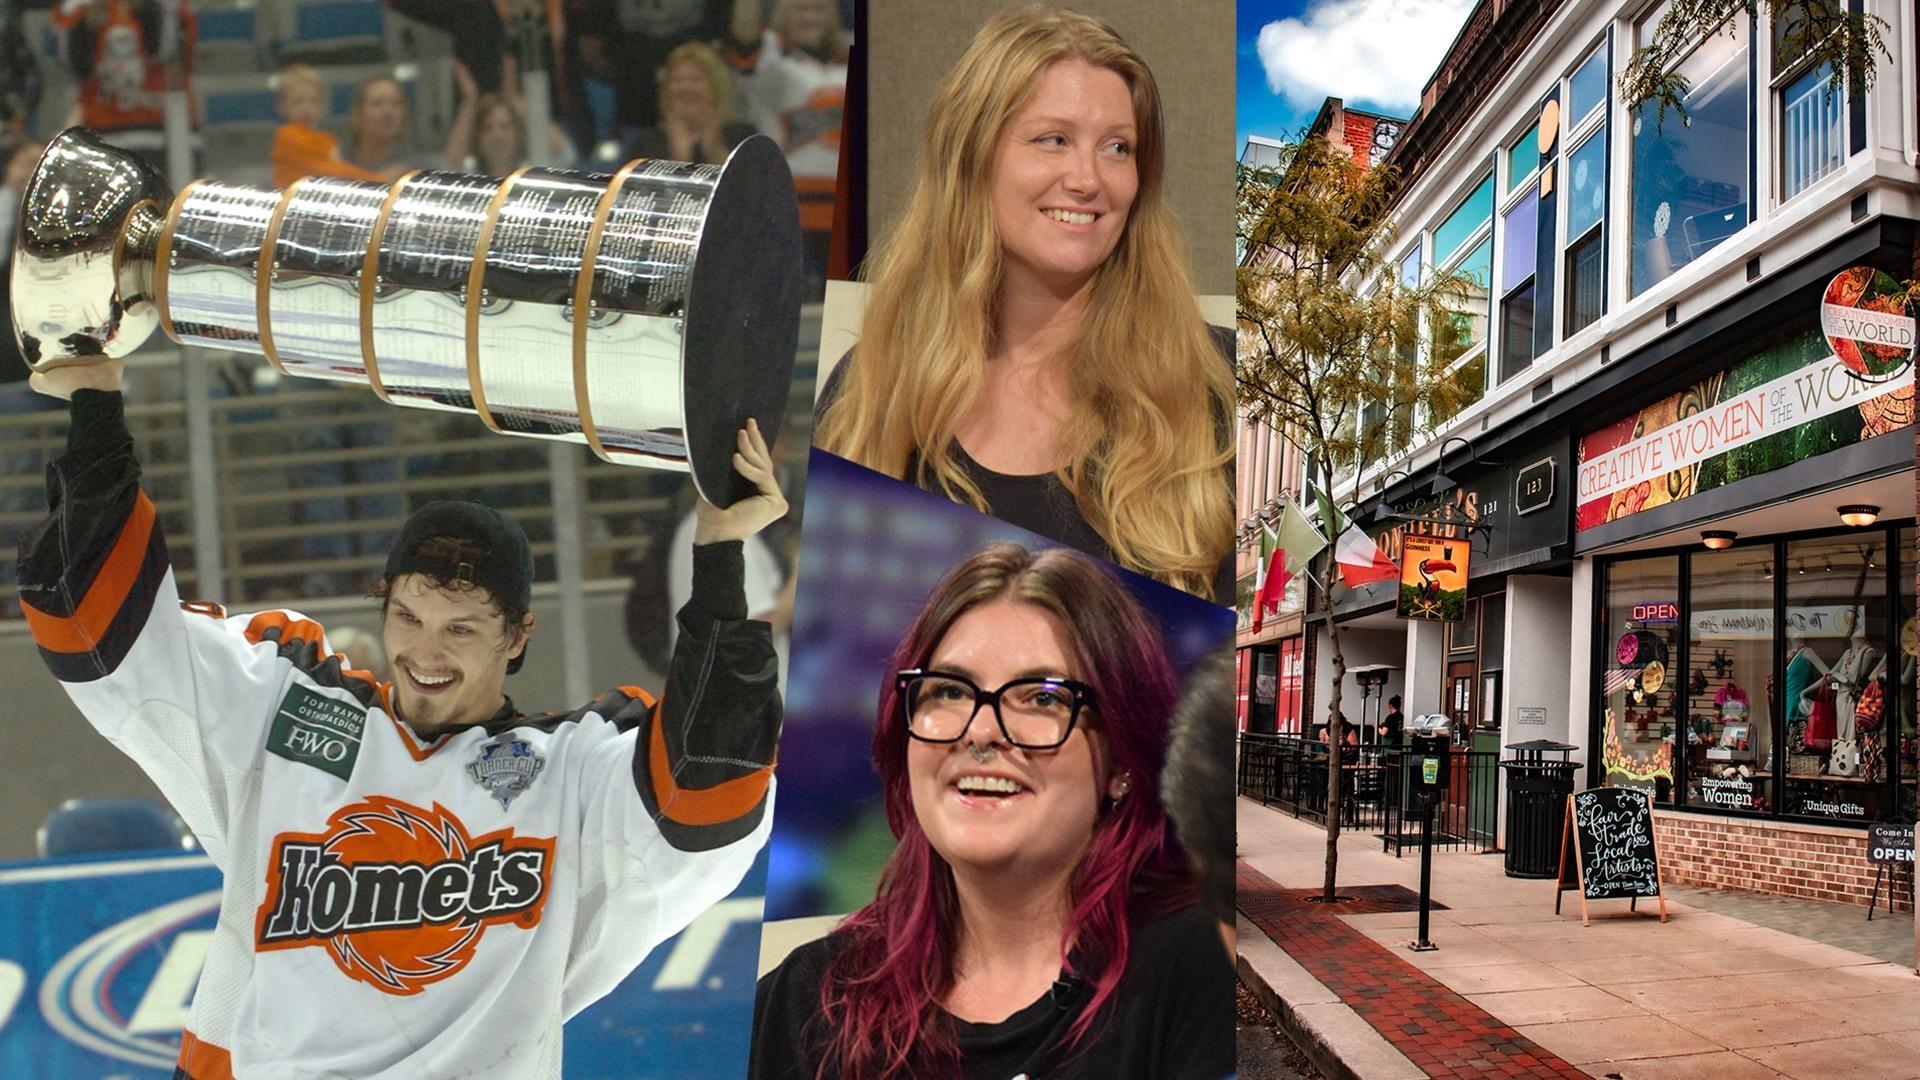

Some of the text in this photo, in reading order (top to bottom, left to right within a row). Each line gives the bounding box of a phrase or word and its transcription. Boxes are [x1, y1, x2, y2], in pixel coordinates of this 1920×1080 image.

[1827, 307, 1872, 322] CREATIVE
[1842, 318, 1911, 345] WORLD
[1771, 387, 1788, 407] OF
[1770, 406, 1794, 427] THE
[1668, 393, 1766, 463] WOMEN
[1579, 437, 1663, 497] CREATIVE
[1526, 478, 1543, 496] 123
[1483, 501, 1497, 516] 121
[1633, 604, 1679, 620] OPEN
[303, 695, 366, 724] FORT WAYNE
[283, 725, 348, 762] FWO
[517, 758, 543, 778] CUP
[1702, 776, 1753, 791] Empowering
[1702, 788, 1752, 806] Women
[1806, 800, 1865, 816] Unique Gifts
[1875, 827, 1914, 837] Come In
[1873, 847, 1916, 862] OPEN
[265, 843, 545, 939] Komets
[1603, 881, 1620, 890] OPEN
